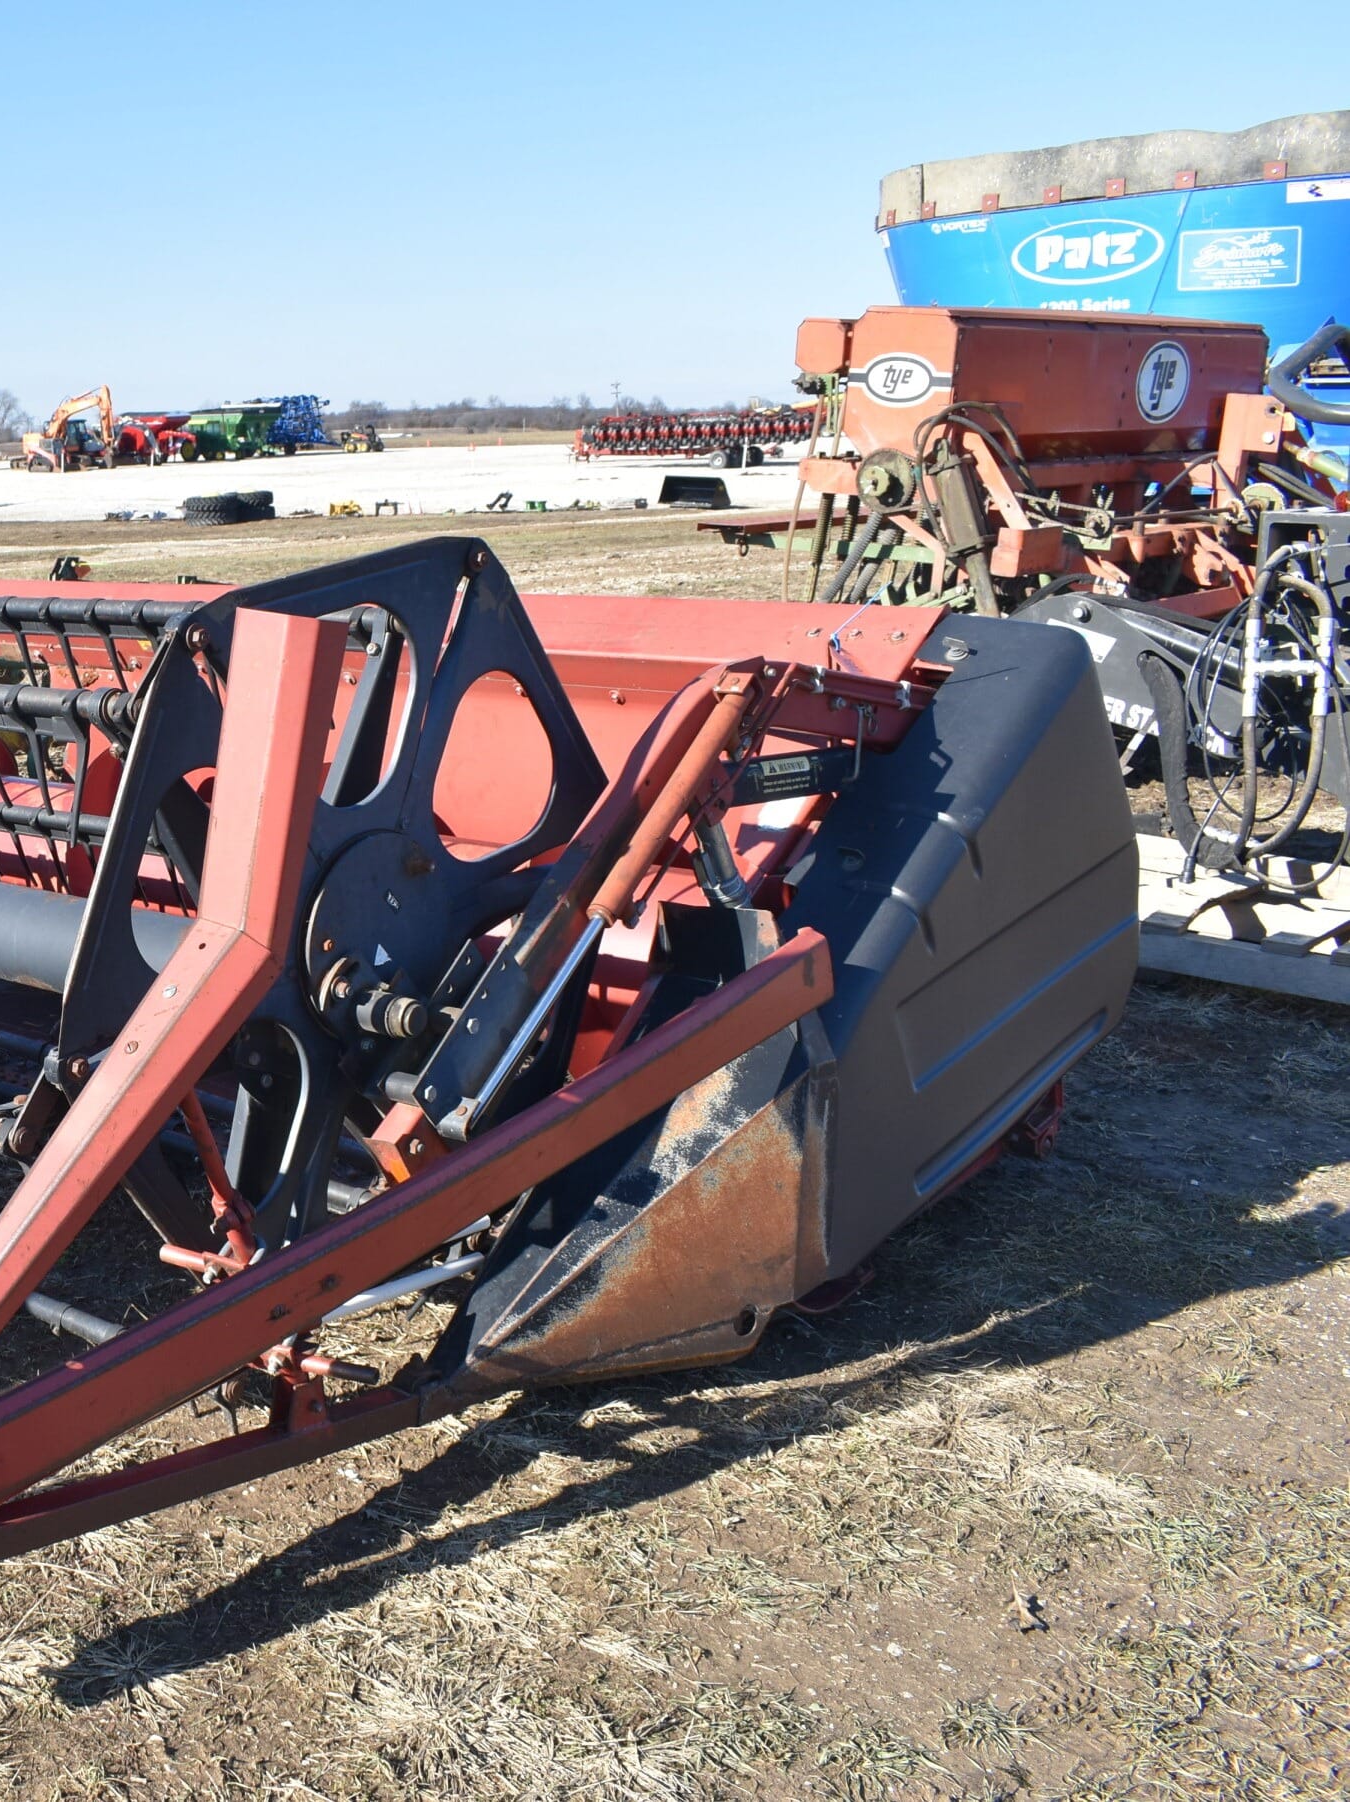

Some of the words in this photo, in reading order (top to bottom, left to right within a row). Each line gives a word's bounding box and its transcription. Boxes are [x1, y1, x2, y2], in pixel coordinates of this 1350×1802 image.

[1081, 296, 1131, 311] Series
[883, 364, 914, 394] tye
[1149, 353, 1178, 411] tye
